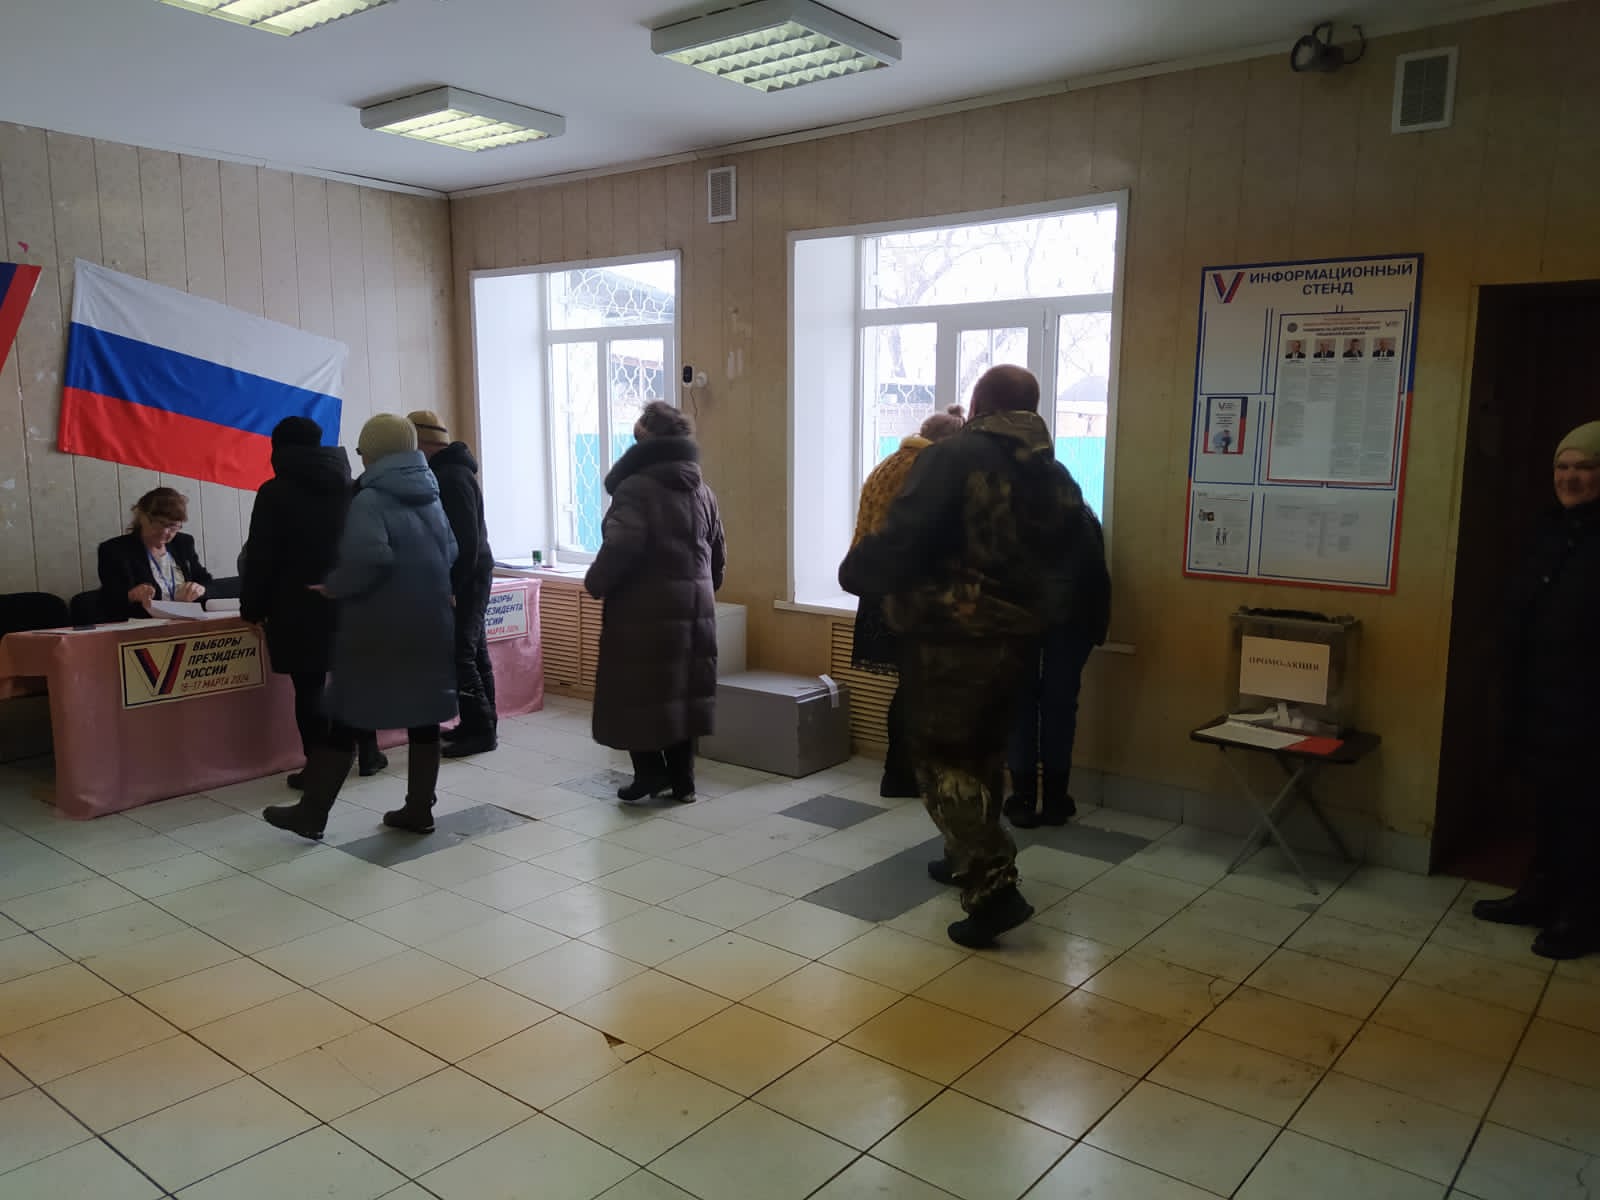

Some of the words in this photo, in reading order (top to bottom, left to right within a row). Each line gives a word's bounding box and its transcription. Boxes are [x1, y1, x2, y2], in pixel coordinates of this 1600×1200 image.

[1249, 262, 1414, 284] ИНФОРМАЦИОННЫЙ
[1302, 282, 1354, 296] СТЕНД
[192, 636, 242, 652] ВЫБОРЫ
[187, 647, 256, 667] ПРЕЗИДЕНТА
[183, 664, 228, 681] РОССИИ
